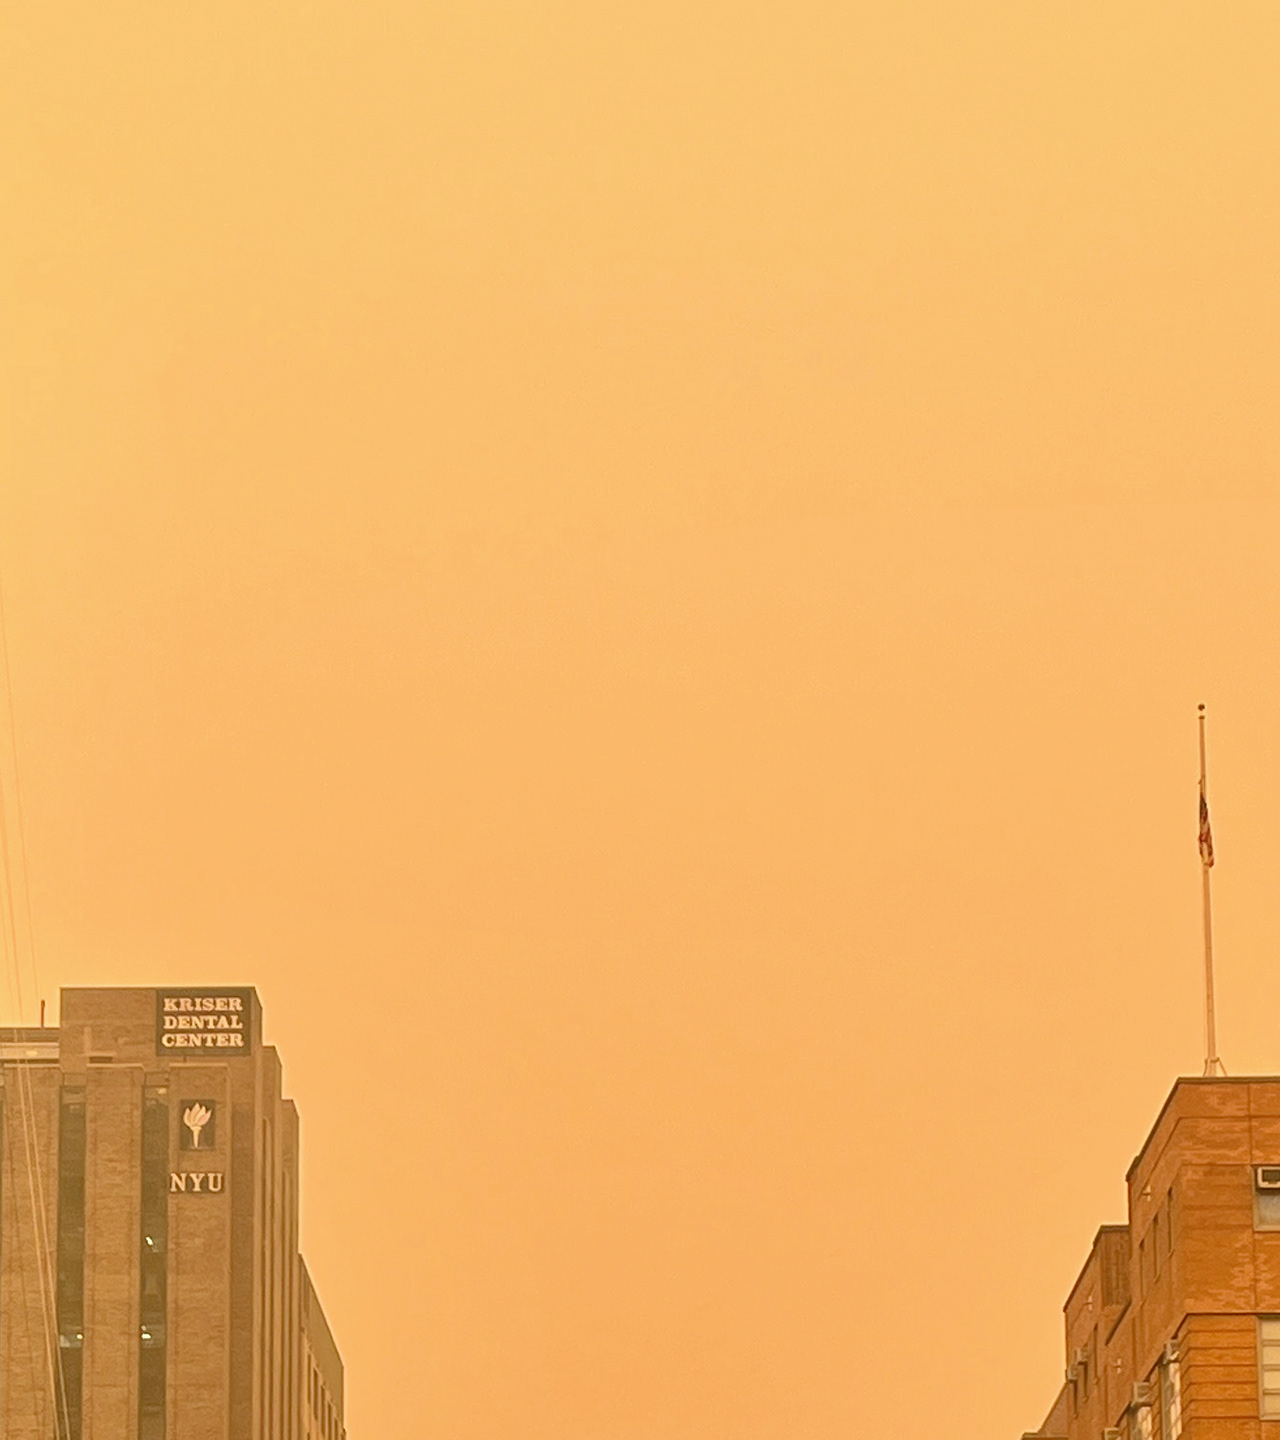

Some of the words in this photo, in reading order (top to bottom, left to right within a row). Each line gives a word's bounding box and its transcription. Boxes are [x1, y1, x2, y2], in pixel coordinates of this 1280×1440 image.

[163, 997, 243, 1012] KRISER
[163, 1015, 243, 1030] DENTAL
[162, 1032, 244, 1047] CENTER
[170, 1172, 224, 1192] NYU
